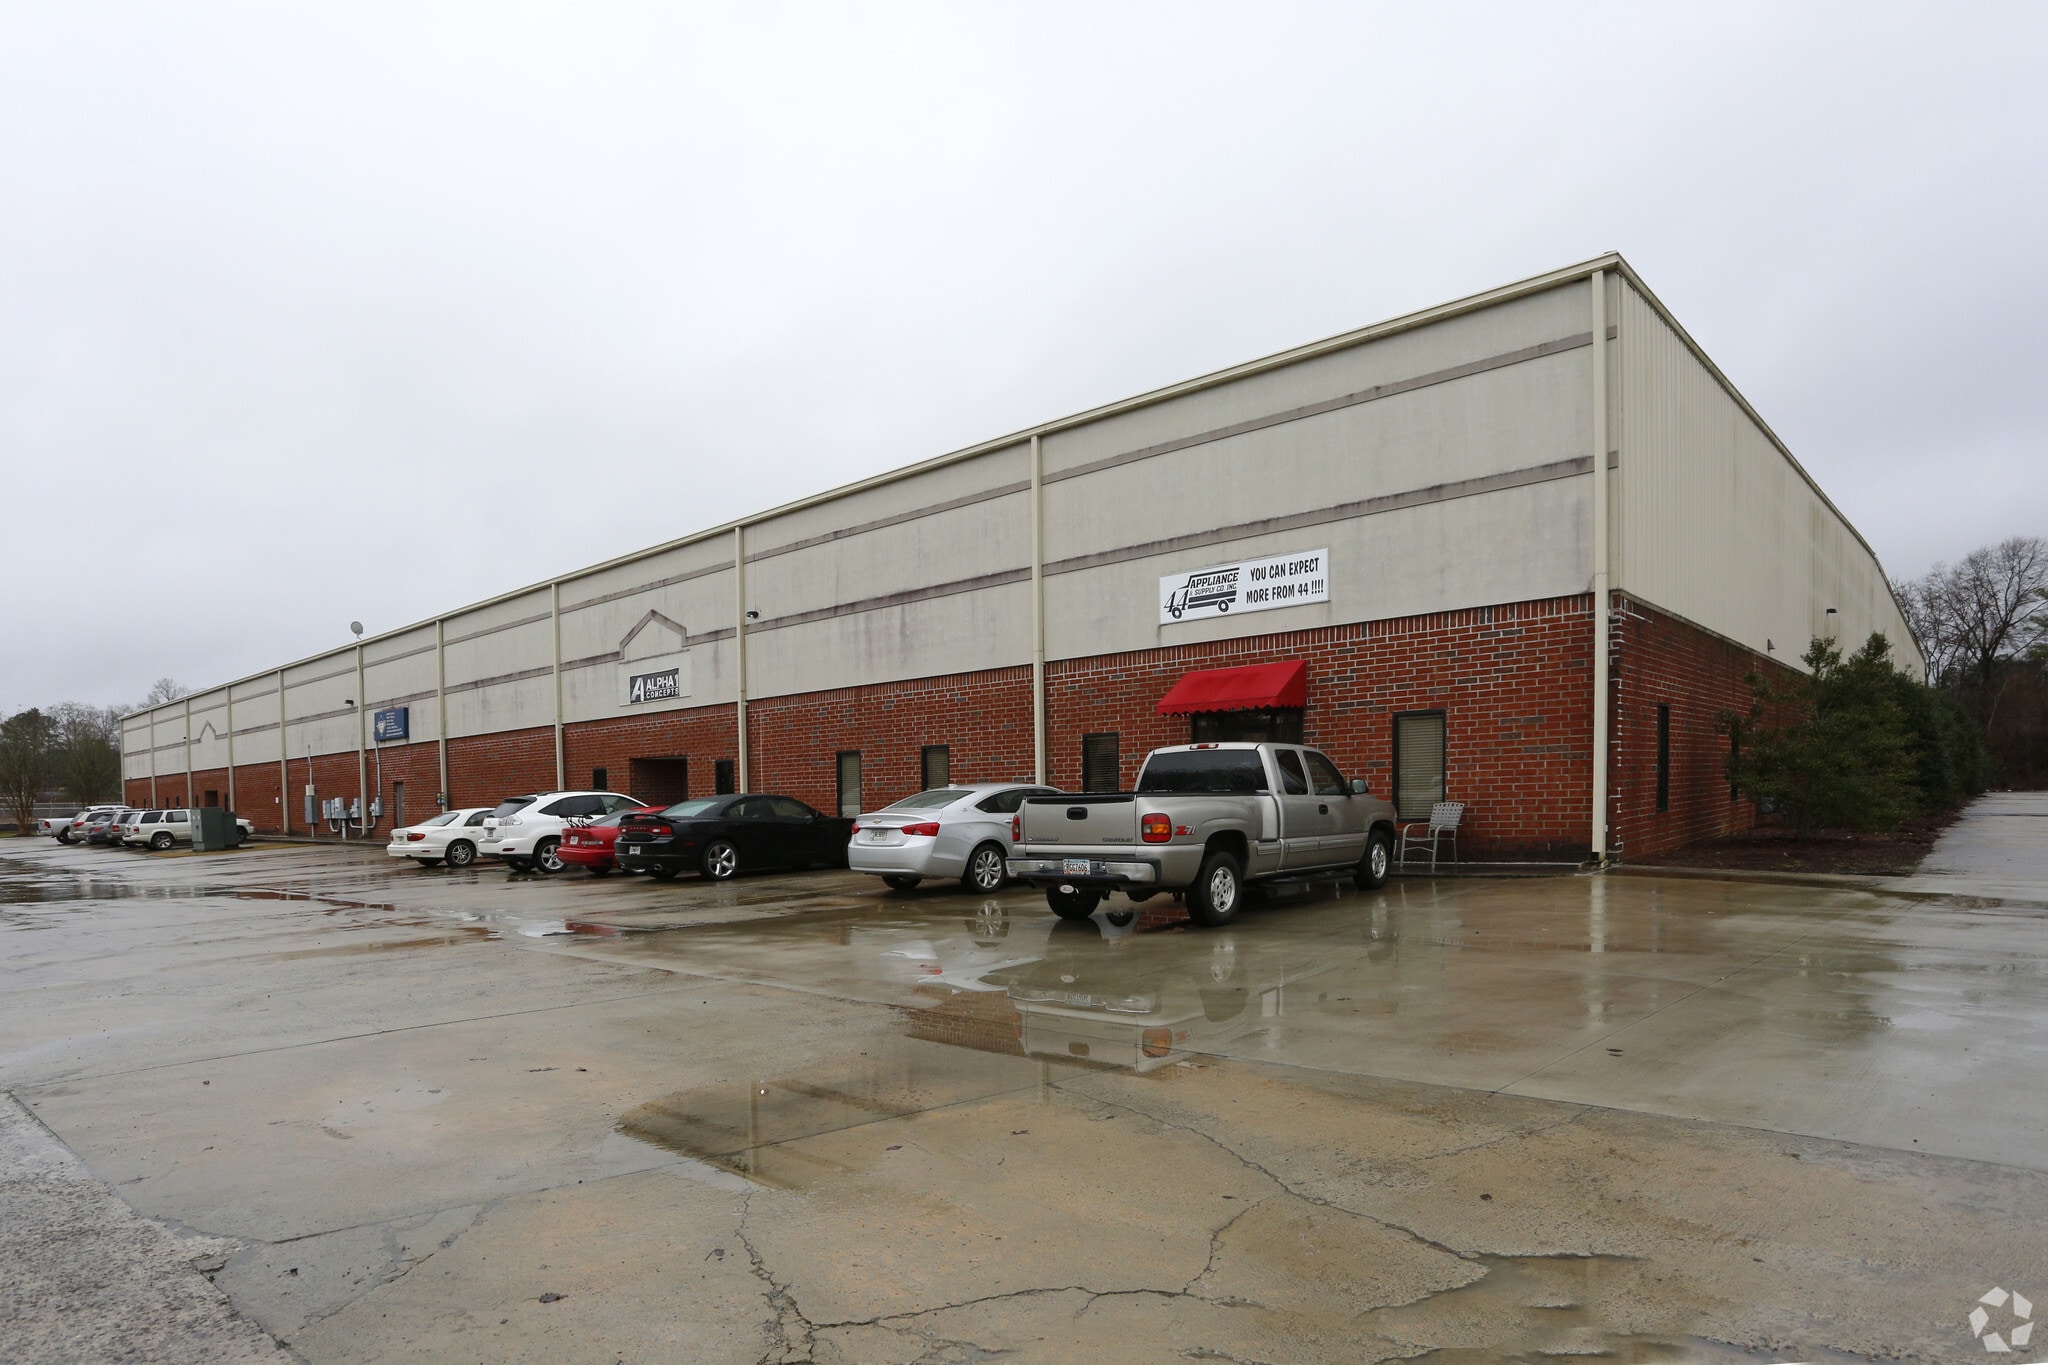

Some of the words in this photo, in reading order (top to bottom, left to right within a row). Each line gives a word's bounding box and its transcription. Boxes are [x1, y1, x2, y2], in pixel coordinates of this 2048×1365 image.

[1250, 566, 1266, 582] YOU
[1269, 562, 1286, 579] CAN
[1289, 557, 1319, 576] EXPECT
[1190, 572, 1239, 589] APPLIANCE
[1194, 585, 1216, 596] SUPPLY
[1246, 588, 1269, 603] MORE
[1272, 583, 1295, 600] FROM
[1297, 582, 1309, 596] 44
[1164, 590, 1189, 612] 44
[646, 688, 679, 698] CONCEPTS
[1174, 825, 1196, 835] Z71
